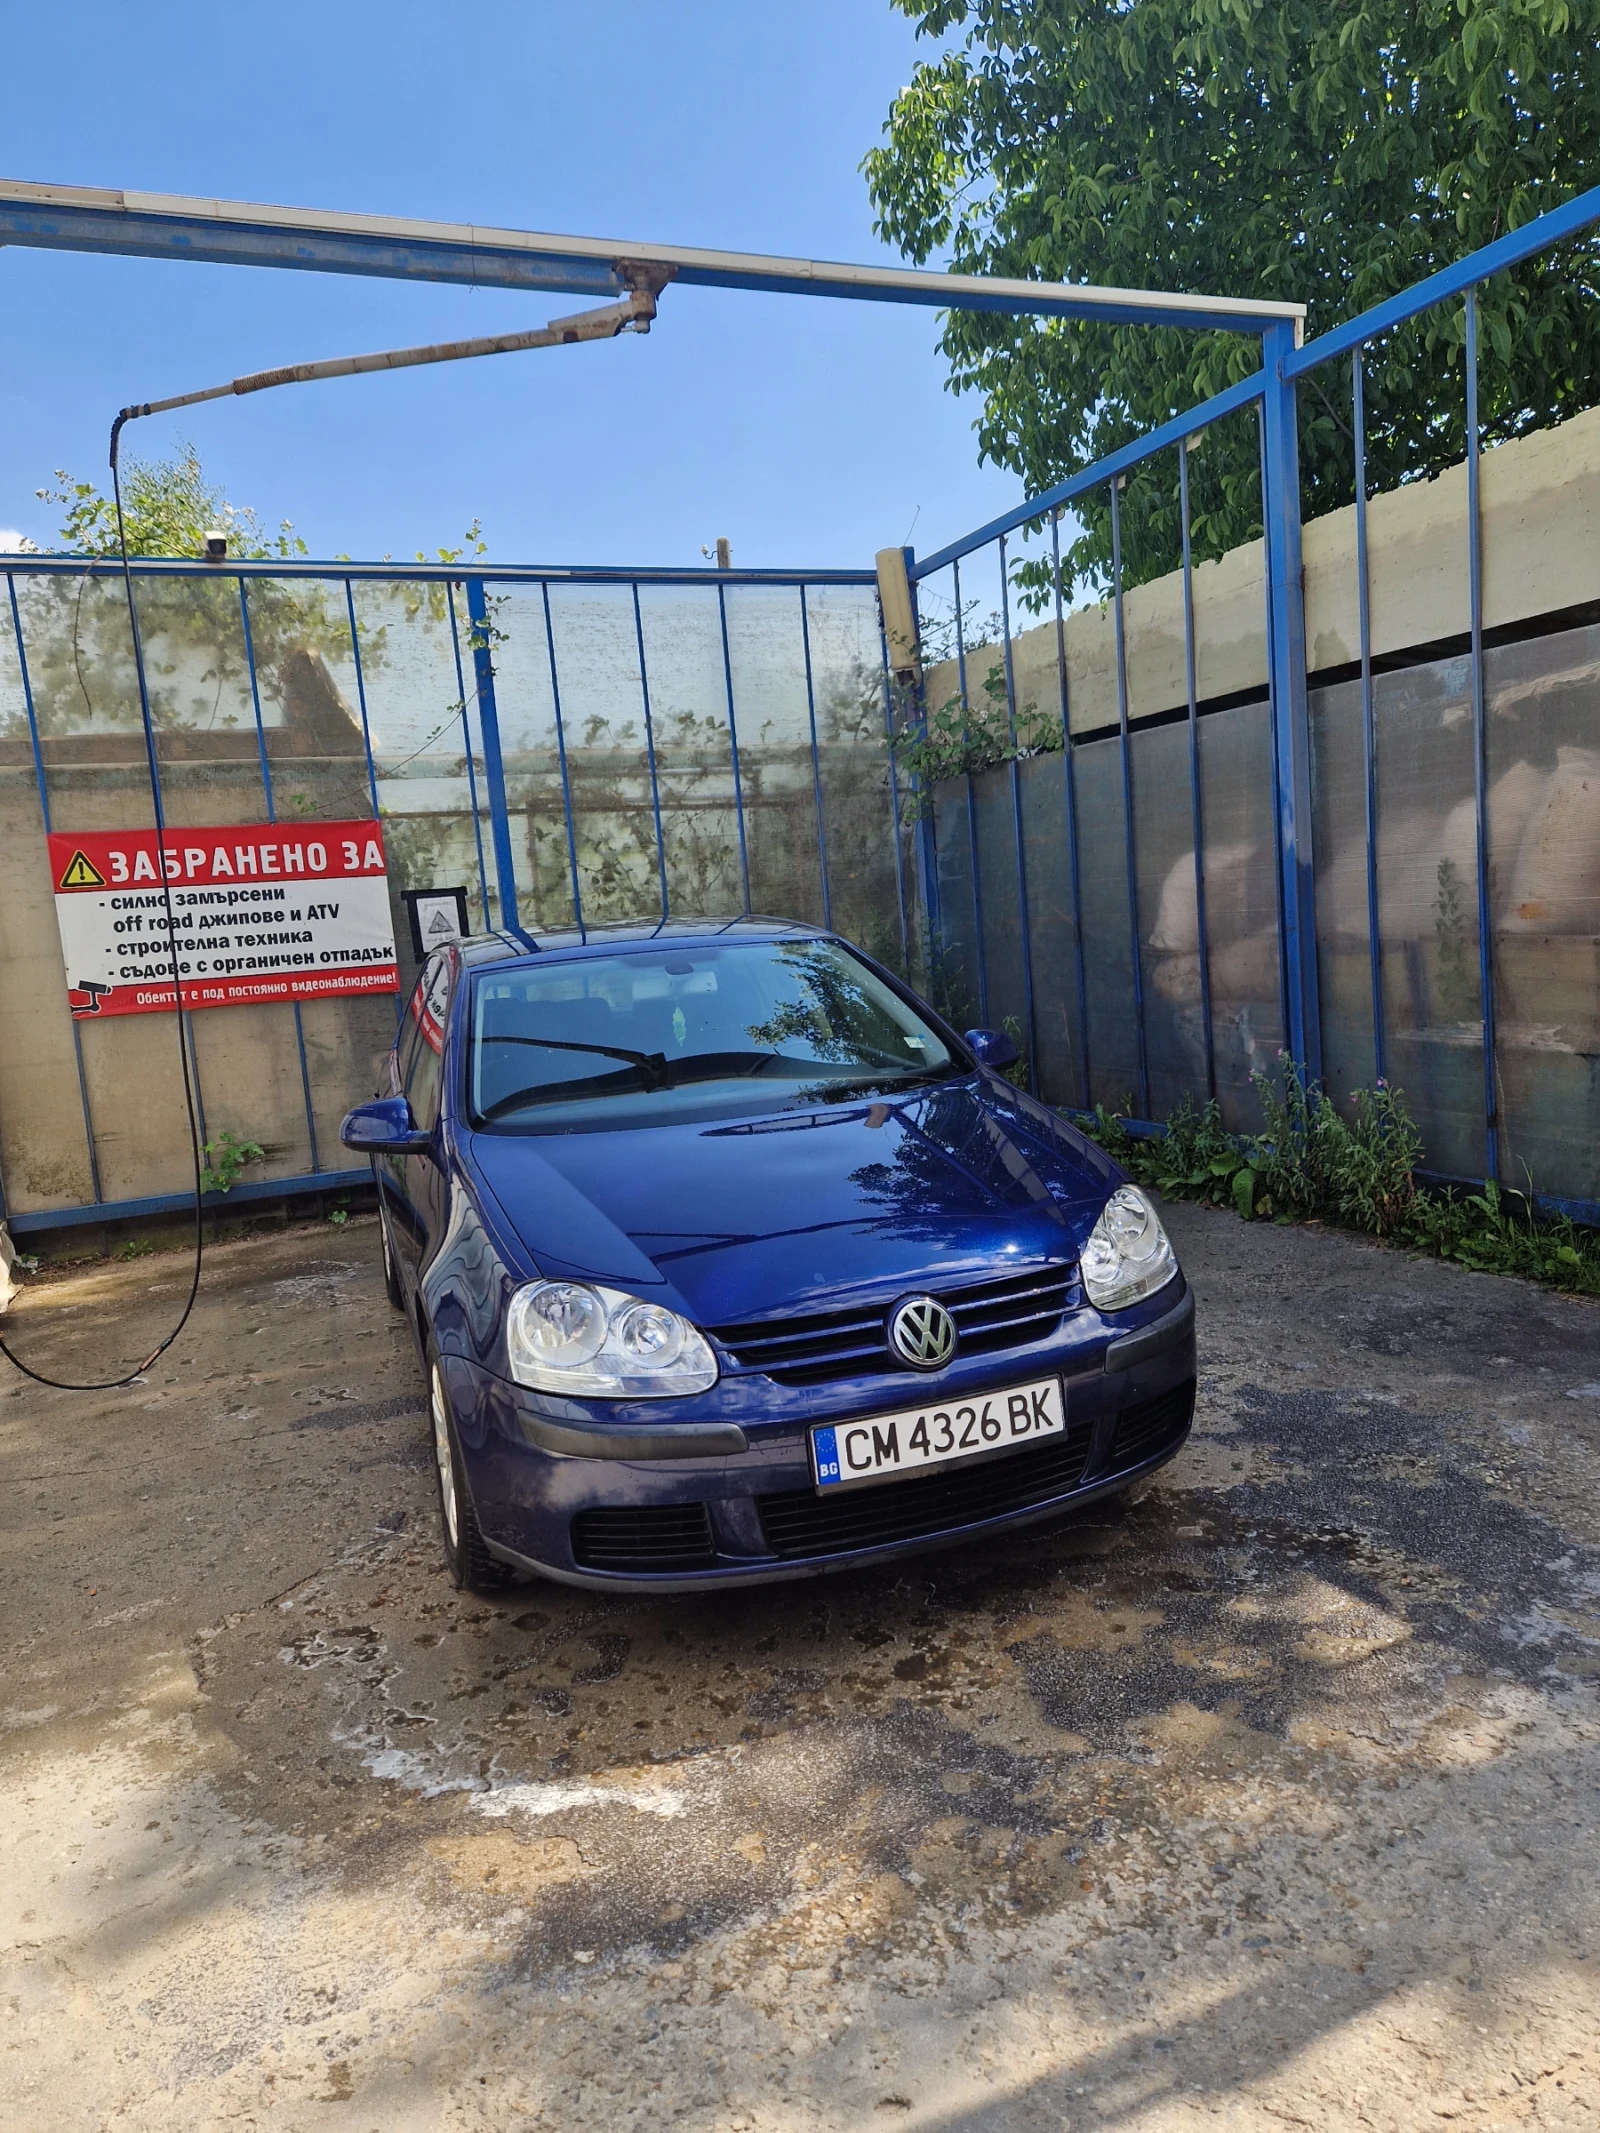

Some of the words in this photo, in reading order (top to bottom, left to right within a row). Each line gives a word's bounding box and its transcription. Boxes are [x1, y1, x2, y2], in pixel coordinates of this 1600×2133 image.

[108, 842, 327, 883] ЗАБРАНЕНО
[342, 840, 384, 870] ЗА
[111, 894, 170, 910] силно
[175, 888, 285, 906] замърсени
[113, 915, 142, 933] off
[148, 912, 193, 931] road
[199, 910, 285, 930] джипове
[290, 909, 301, 922] и
[307, 903, 340, 920] ATV
[117, 936, 230, 957] строителна
[235, 930, 313, 947] техника
[120, 961, 191, 979] съдове
[196, 960, 208, 973] с
[212, 951, 314, 974] органичен
[320, 946, 394, 963] отпадък
[190, 990, 199, 1000] е
[203, 988, 225, 1000] под
[228, 983, 287, 997] постоянно
[292, 972, 396, 992] видеонаблюдение!
[894, 1300, 956, 1366] VW
[845, 1421, 900, 1471] CM
[909, 1401, 1001, 1457] 4326
[1007, 1387, 1054, 1436] BK
[820, 1462, 838, 1477] BG
